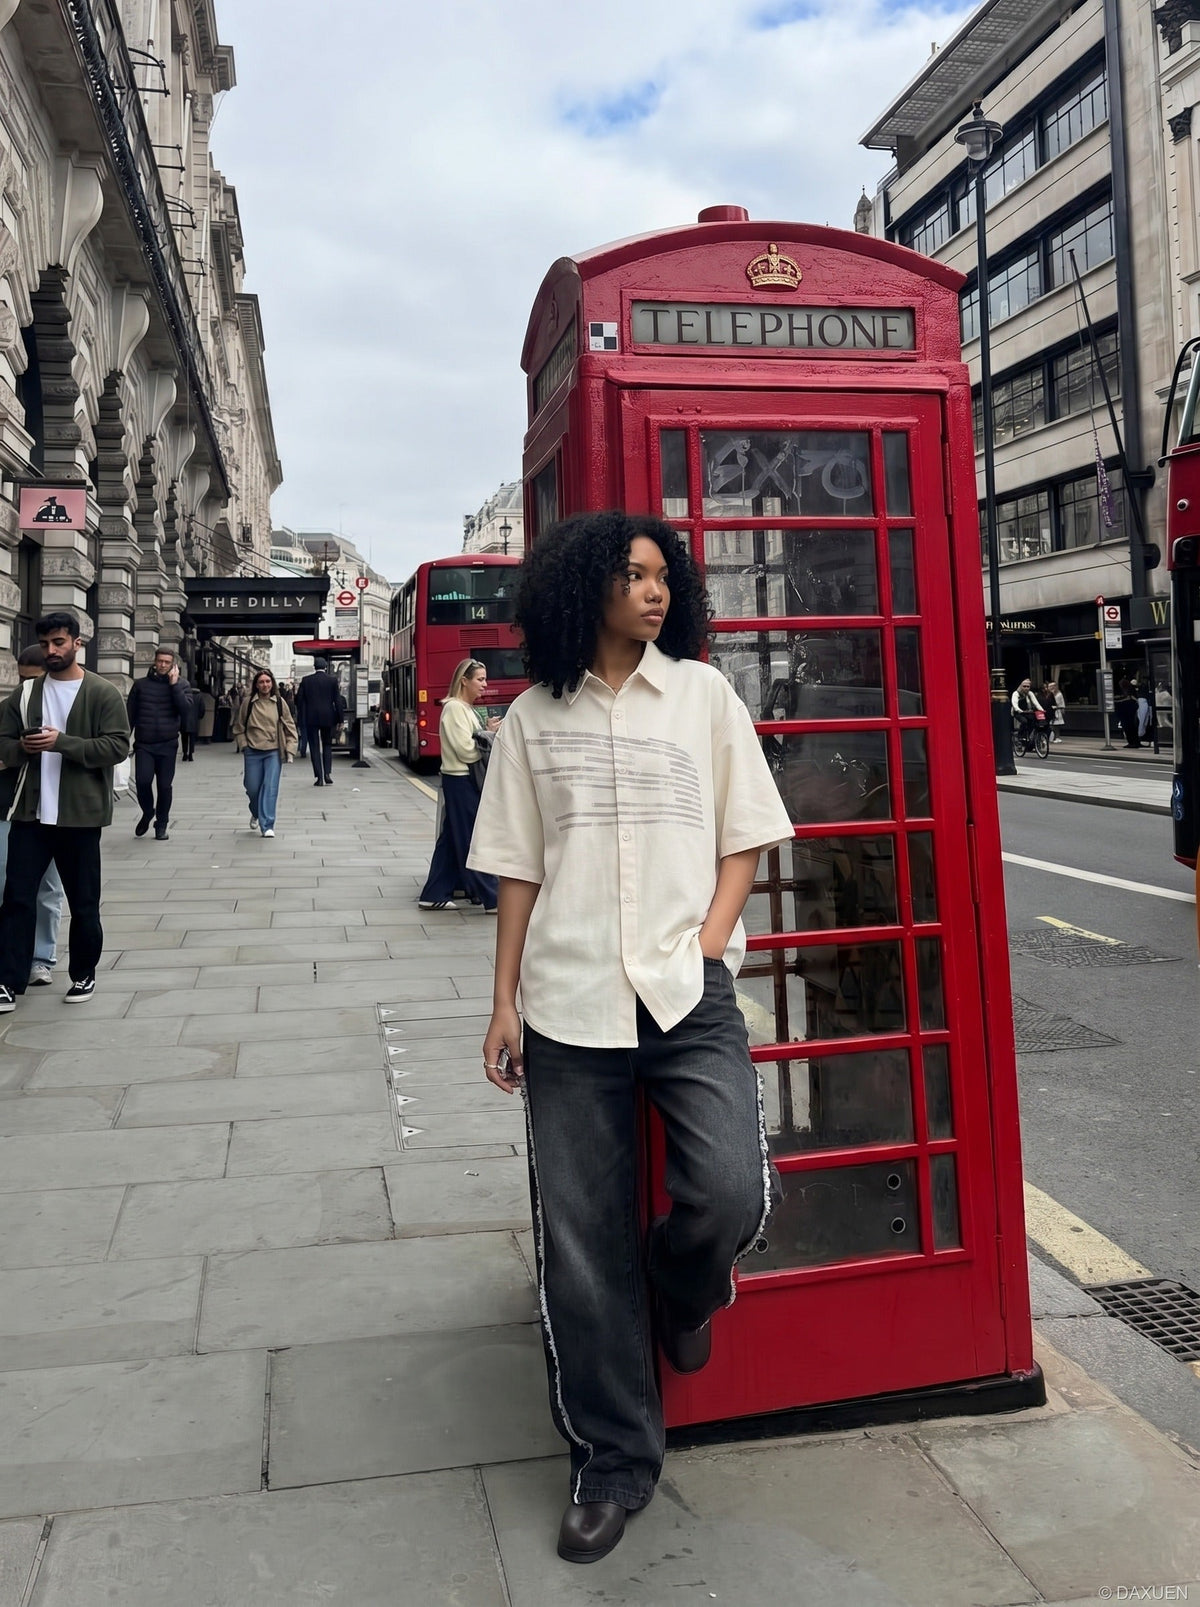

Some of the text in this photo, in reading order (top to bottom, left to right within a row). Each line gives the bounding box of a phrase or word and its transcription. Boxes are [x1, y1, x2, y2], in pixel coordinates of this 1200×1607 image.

[640, 308, 903, 348] TELEPHONE
[202, 596, 306, 608] THE DILLY
[471, 606, 486, 620] 14
